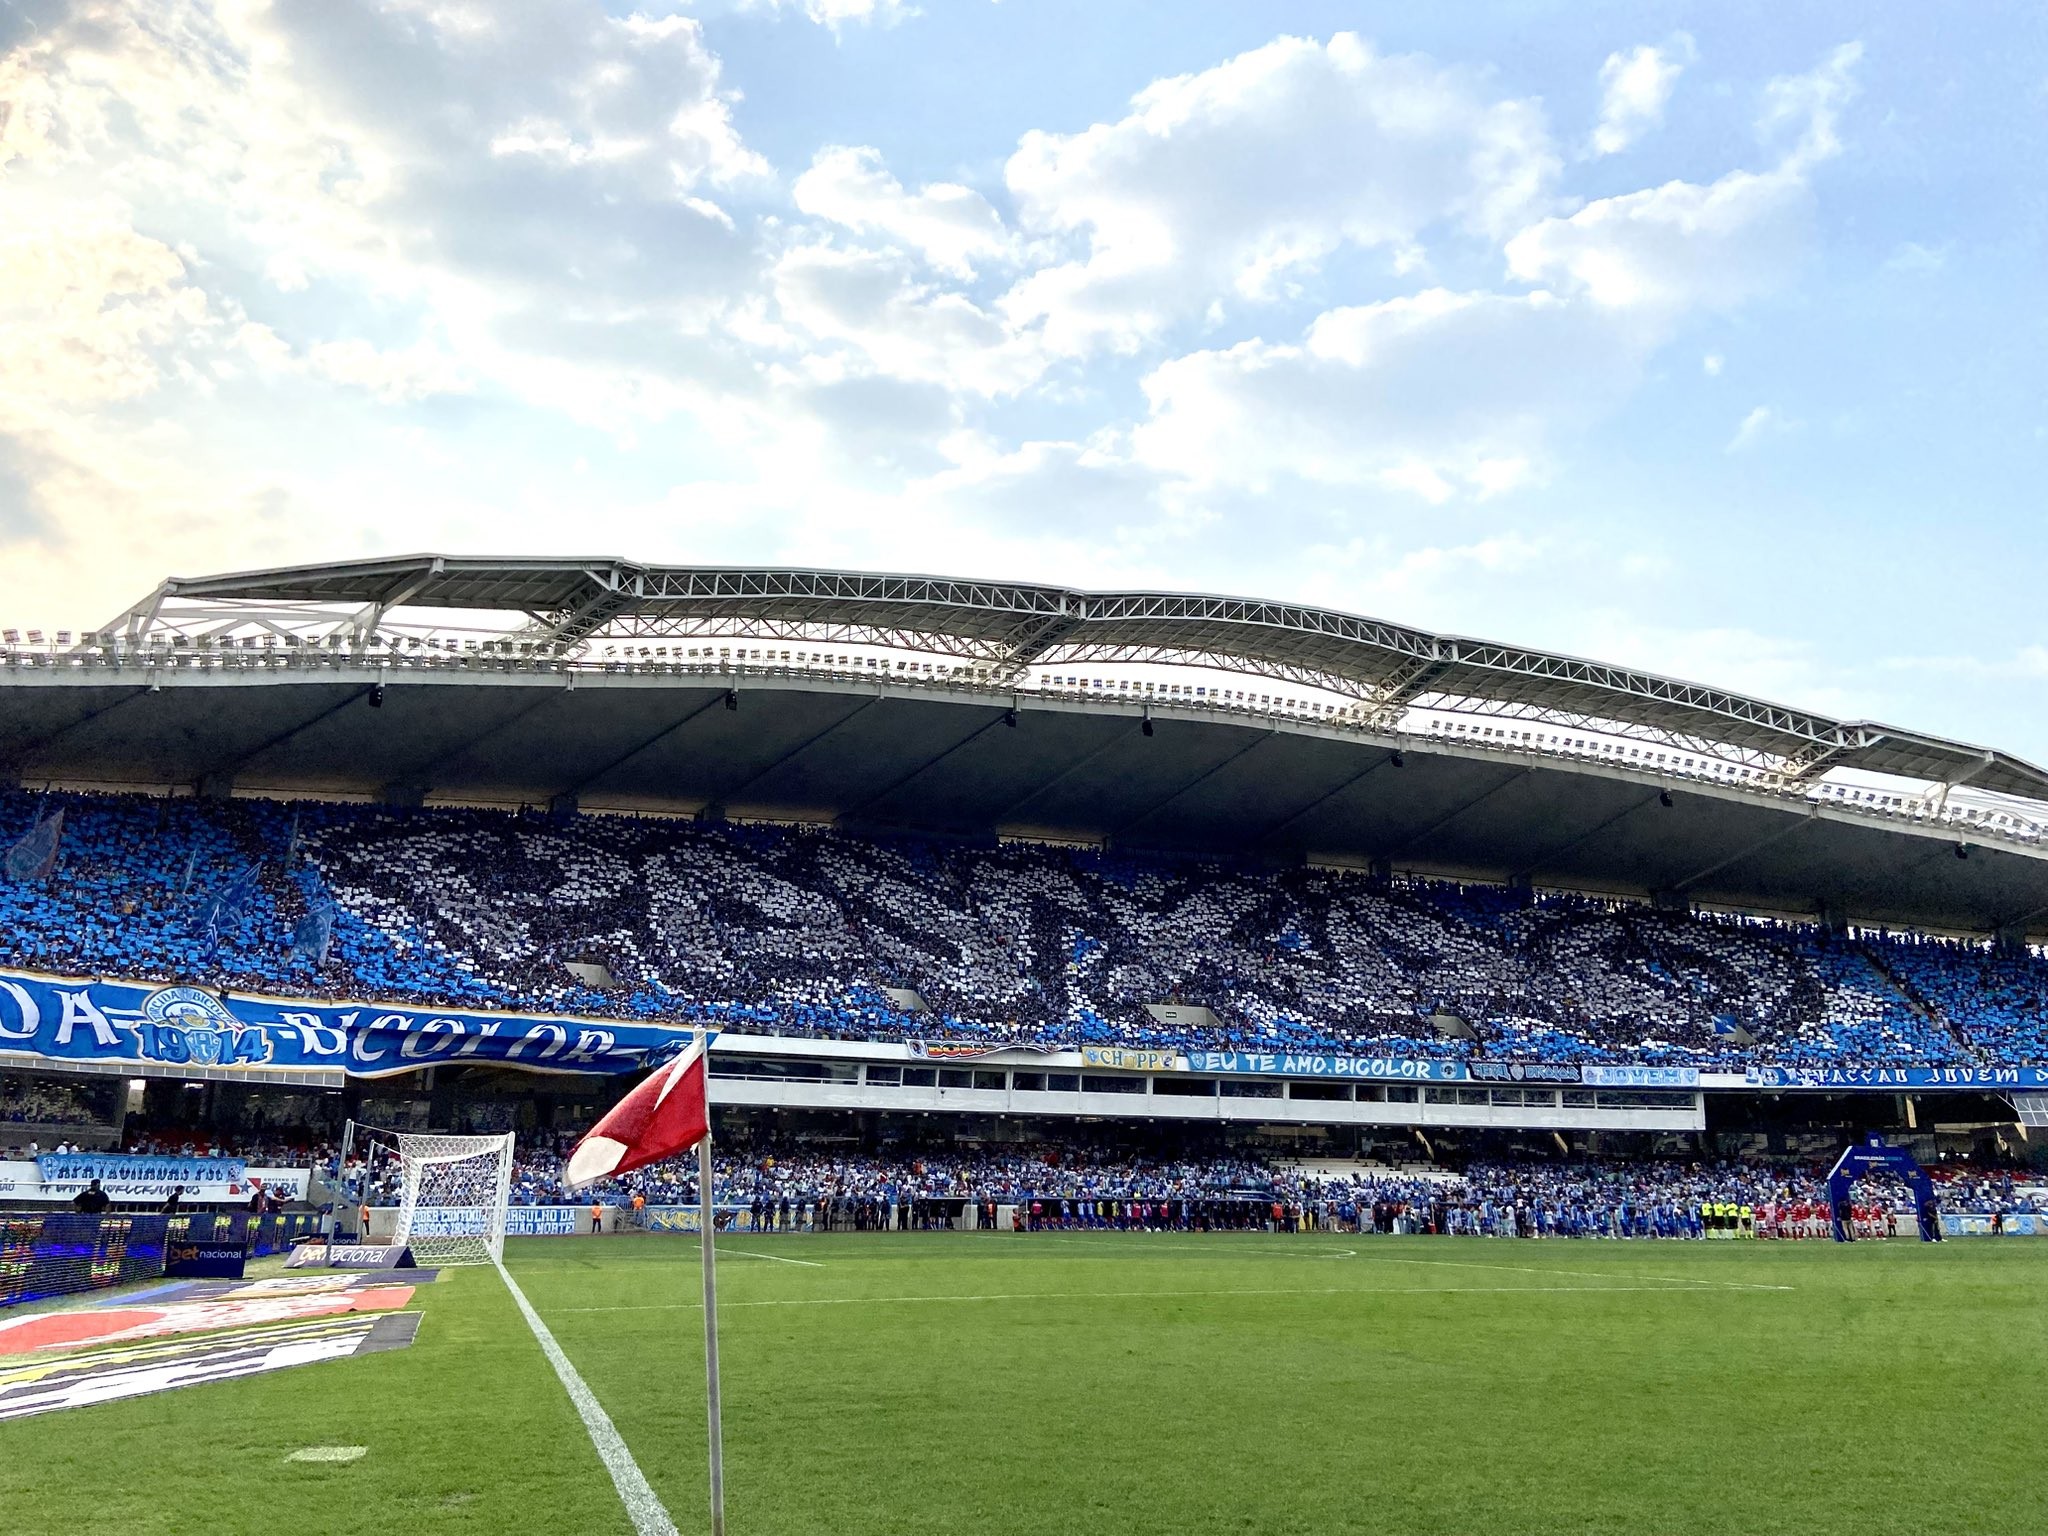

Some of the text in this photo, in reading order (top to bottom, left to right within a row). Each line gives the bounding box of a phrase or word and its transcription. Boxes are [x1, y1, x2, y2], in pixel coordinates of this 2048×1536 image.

[137, 1025, 269, 1065] 1914
[1205, 1052, 1238, 1070] EU
[1245, 1054, 1276, 1071] TE
[1600, 1068, 1682, 1085] JOVEM
[1924, 1069, 2019, 1083] JOVEM
